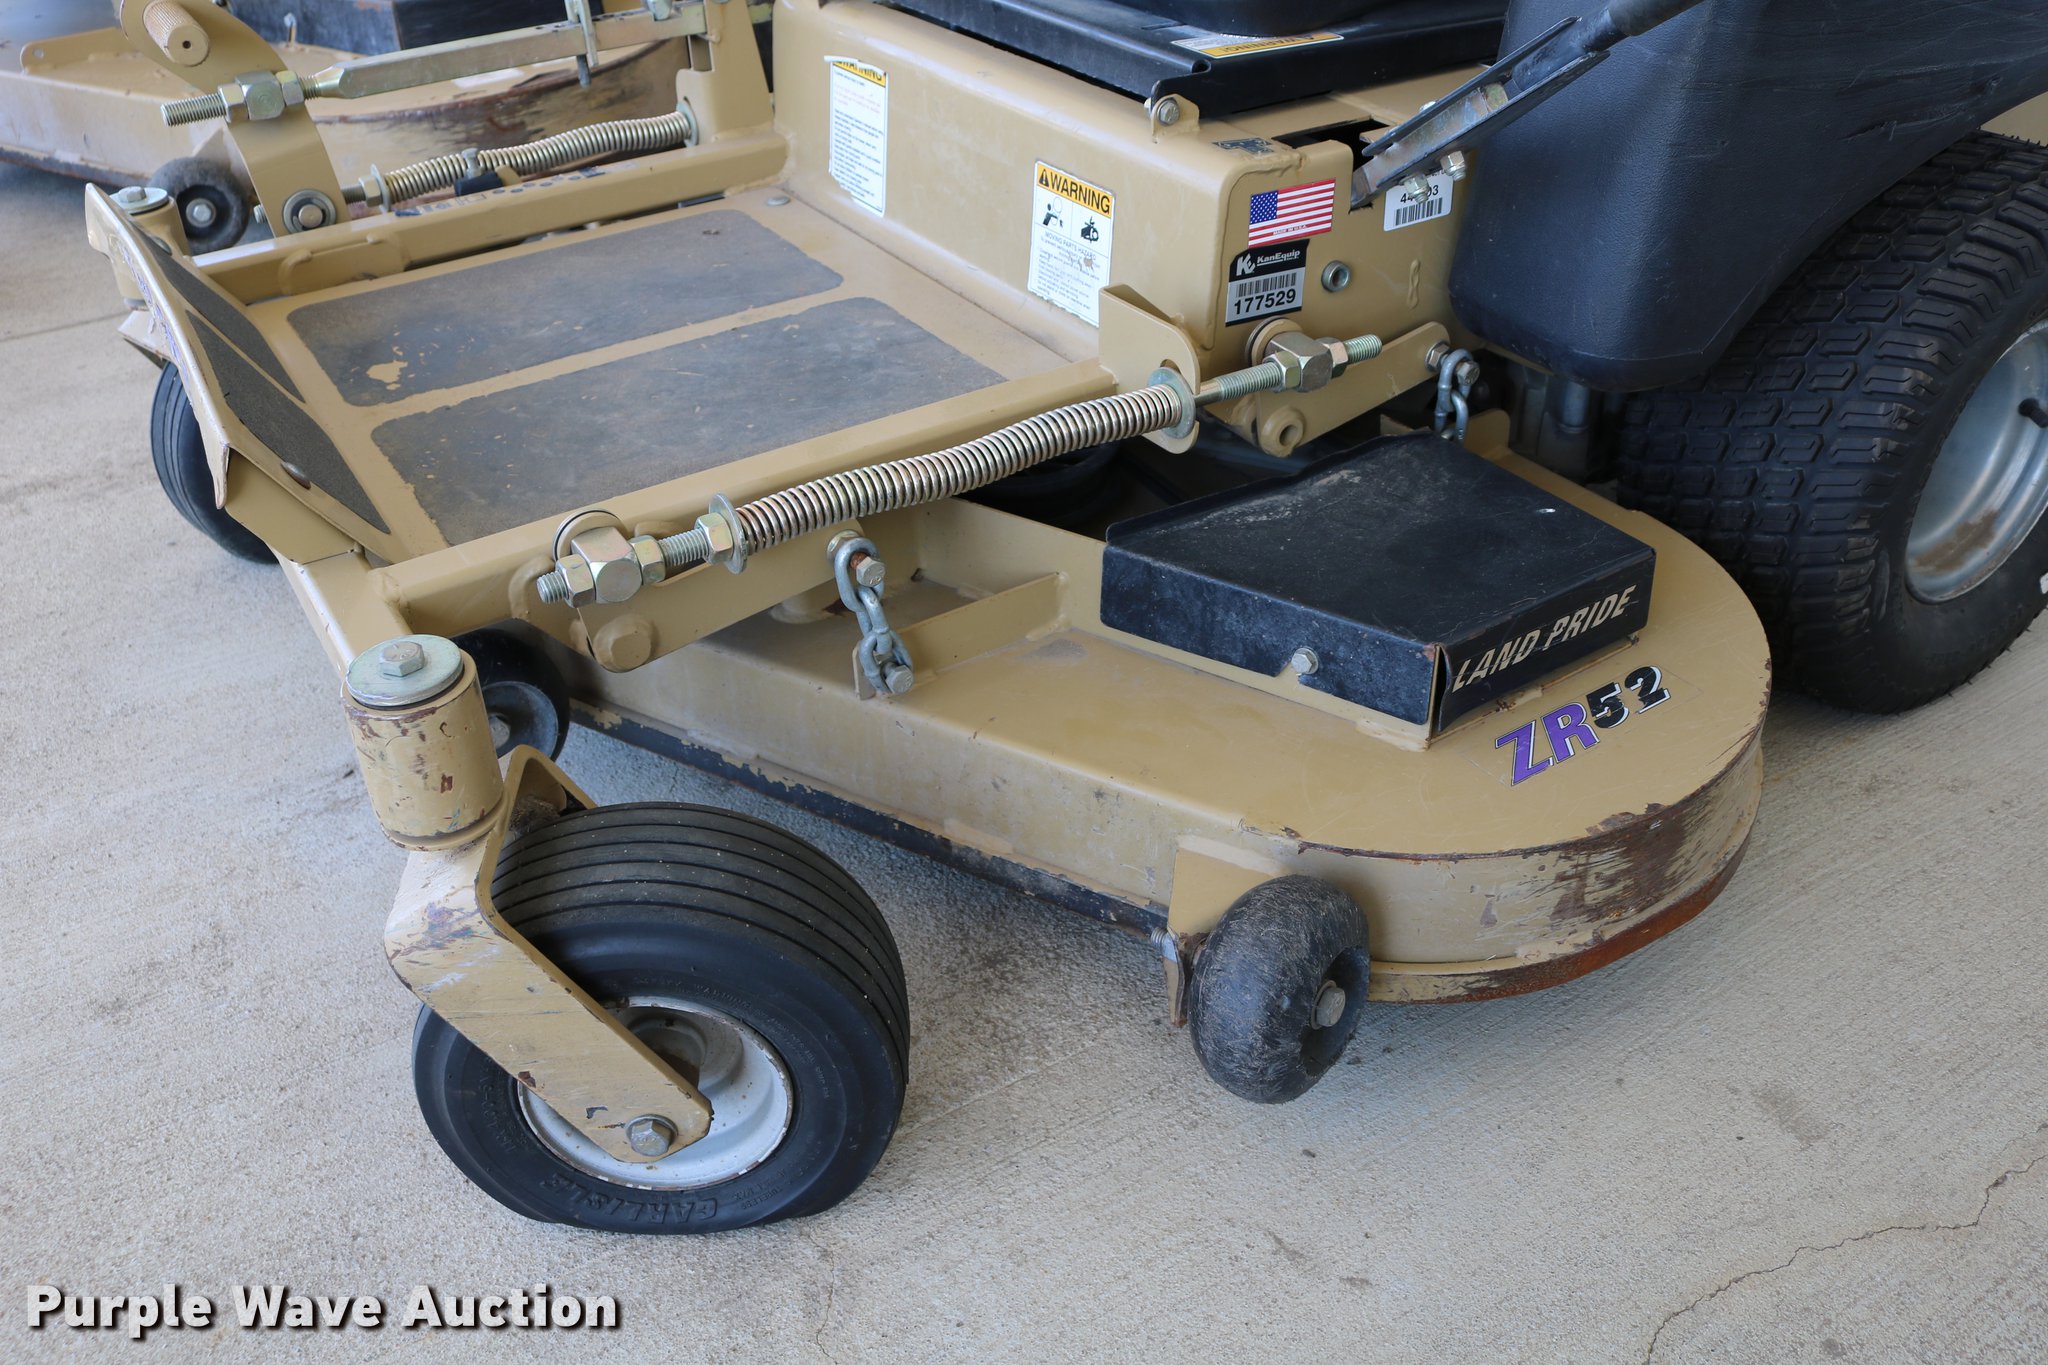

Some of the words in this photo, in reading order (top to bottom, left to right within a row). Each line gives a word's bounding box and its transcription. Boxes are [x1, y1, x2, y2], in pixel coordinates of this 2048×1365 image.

[1050, 172, 1111, 214] WARNING
[1045, 231, 1062, 246] MOVING
[1063, 239, 1077, 252] PARTS
[1078, 245, 1097, 261] HAZARD
[1257, 249, 1301, 264] KanEquip
[1234, 288, 1297, 315] 177529
[1452, 629, 1541, 693] LAND
[1544, 584, 1637, 651] PRIDE
[1495, 663, 1671, 787] ZR52
[538, 1171, 718, 1226] CARLISLE
